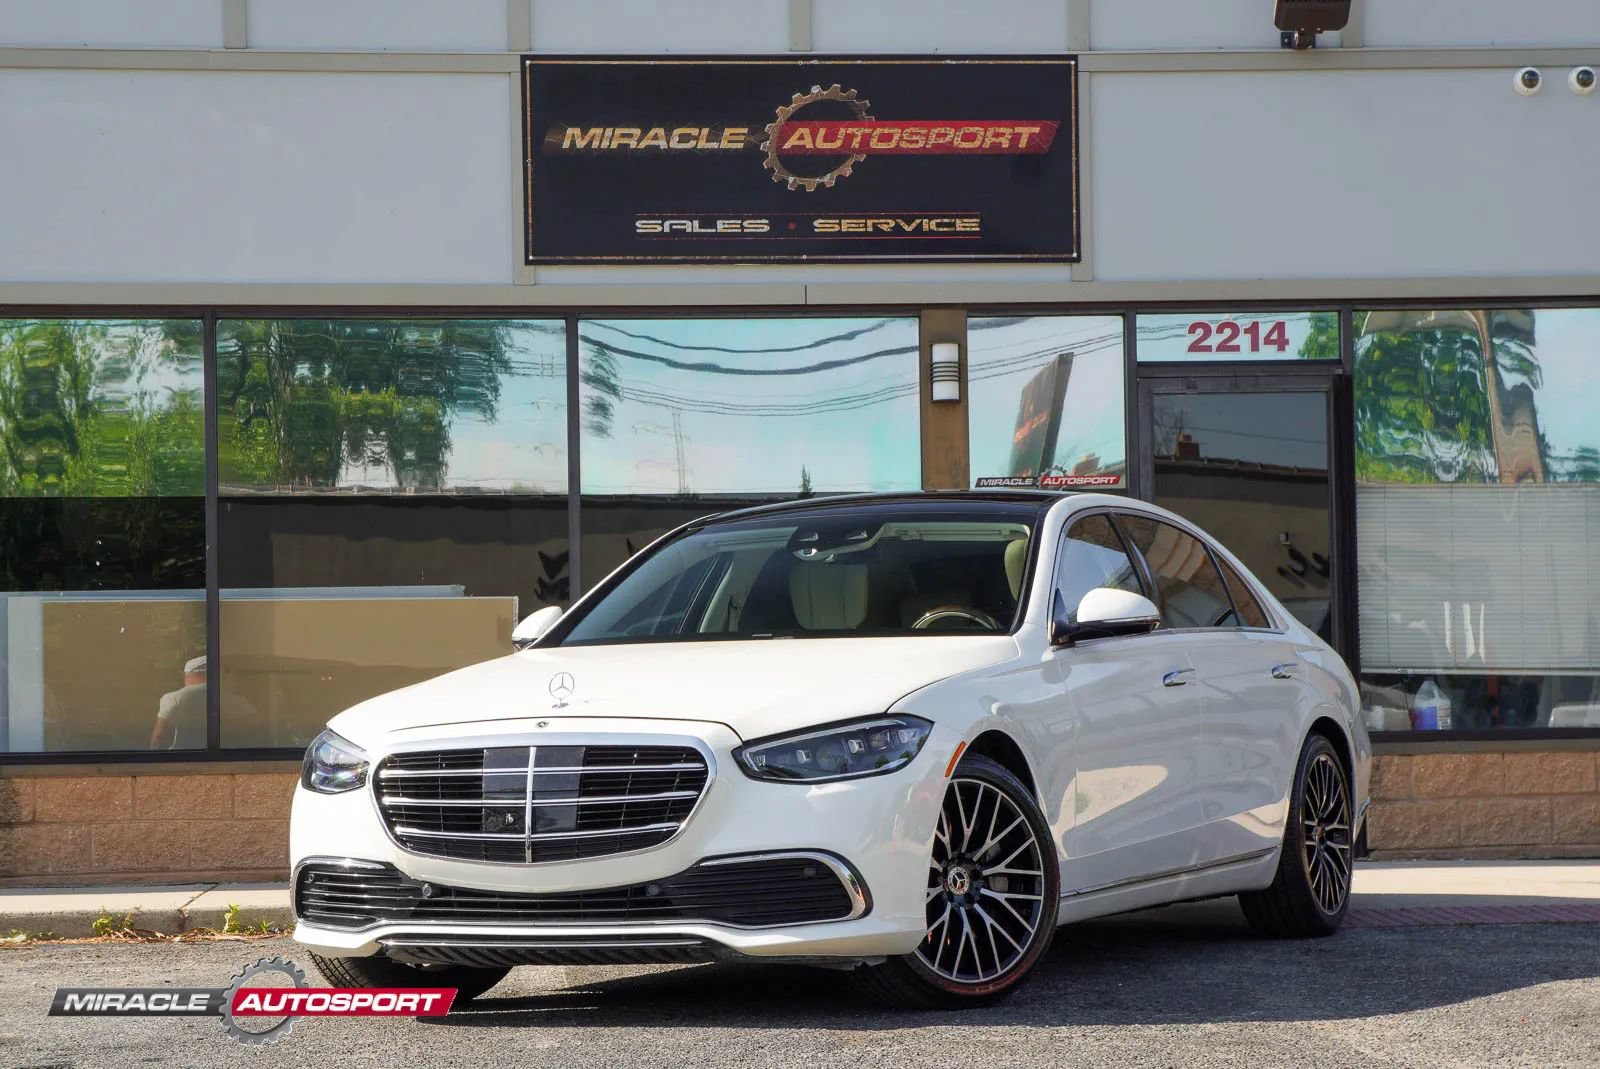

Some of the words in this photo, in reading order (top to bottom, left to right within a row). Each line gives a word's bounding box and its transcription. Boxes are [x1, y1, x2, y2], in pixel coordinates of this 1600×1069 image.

[562, 127, 749, 149] MIRACLE
[782, 127, 1041, 149] AUTOSPORT
[635, 218, 770, 233] SALES
[813, 218, 981, 232] SERVICE
[1187, 320, 1290, 353] 2214
[980, 477, 1033, 486] MIRACLE
[1042, 476, 1117, 485] AUTOSPORT
